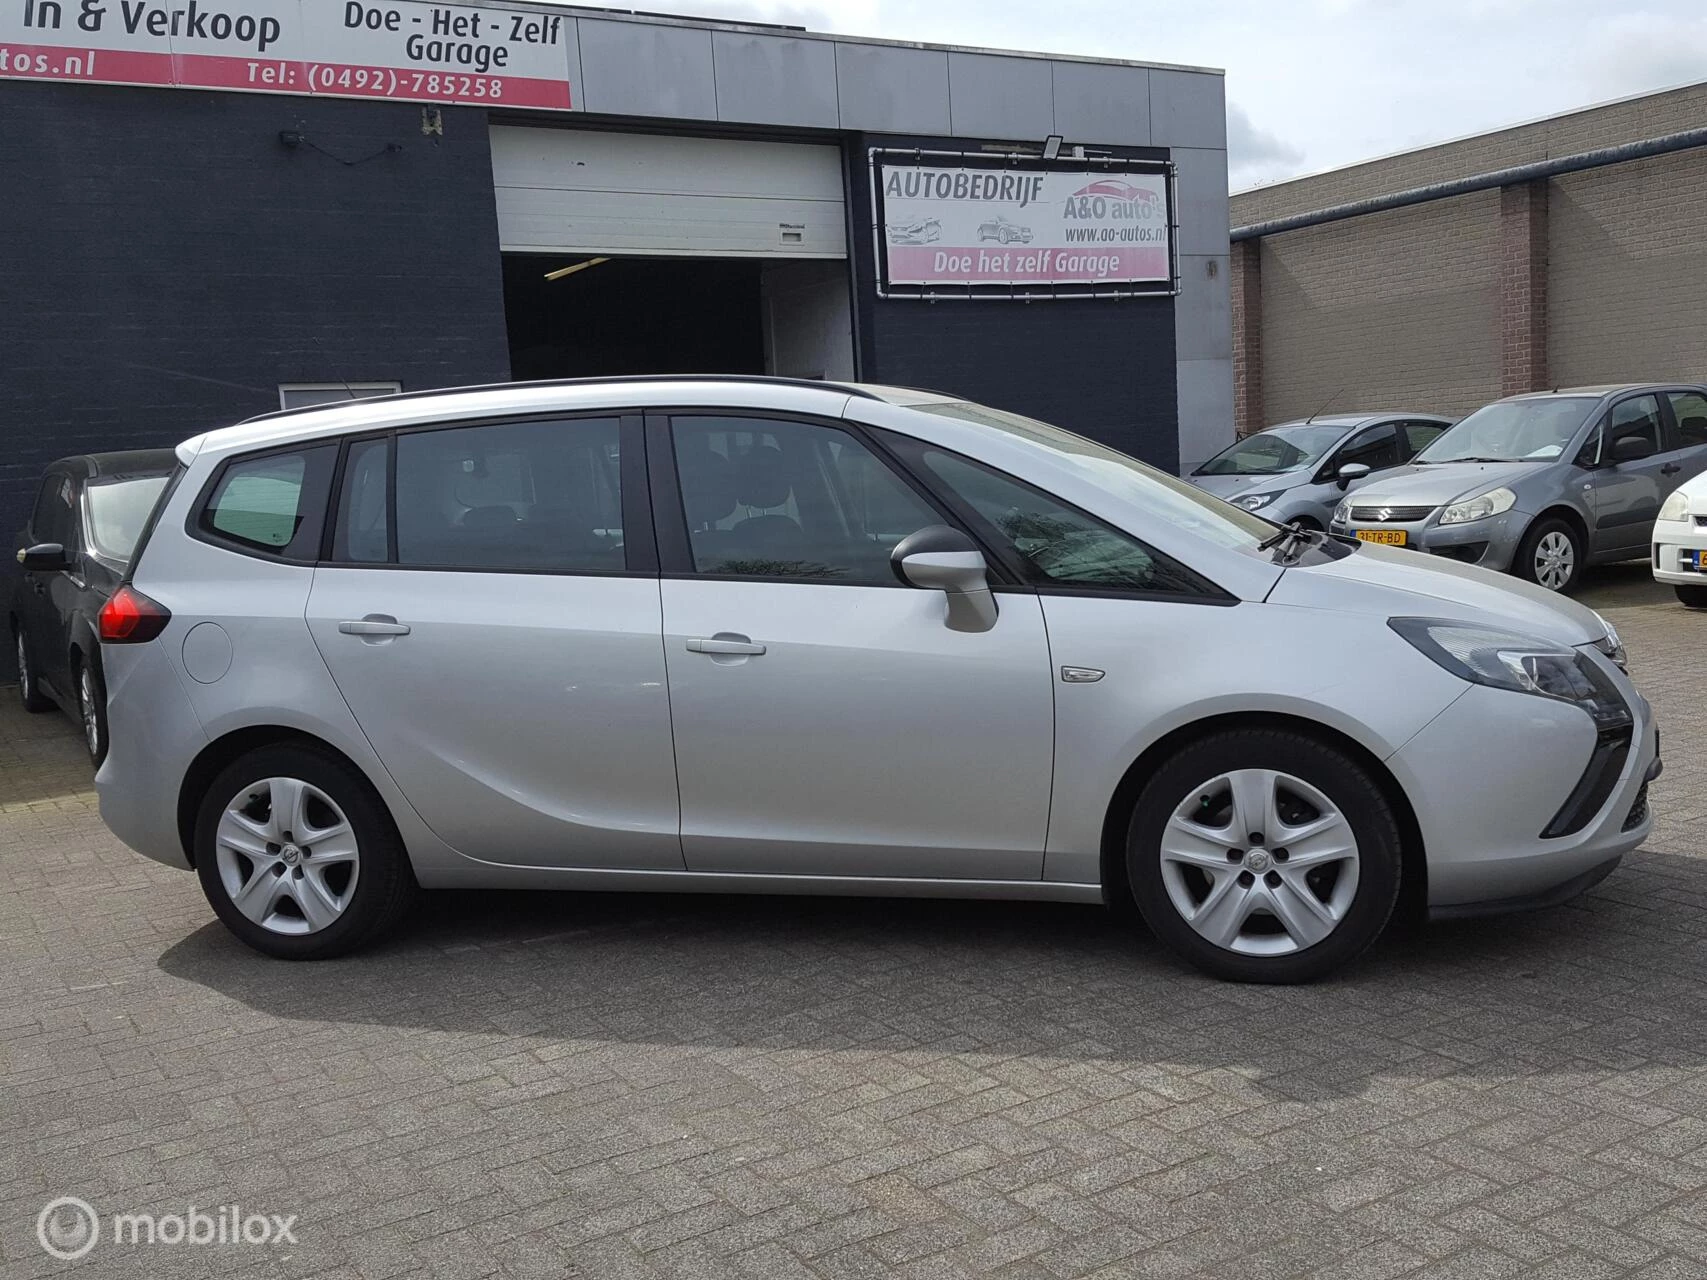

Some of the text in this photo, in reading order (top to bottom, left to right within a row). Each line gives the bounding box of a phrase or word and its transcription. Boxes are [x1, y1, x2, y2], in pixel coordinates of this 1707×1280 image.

[24, 0, 281, 52] In & Verkoop
[344, 2, 401, 31] Doe
[432, 9, 481, 38] Het
[509, 15, 561, 45] Zelf
[406, 34, 508, 73] Garage
[247, 62, 502, 98] Tel: (0492)-785258
[885, 171, 1044, 208] AUTOBEDRIJF
[1063, 195, 1107, 219] A&O
[1065, 225, 1167, 242] www.ao-autos.nl
[934, 250, 1120, 276] Doe het zelf Garage
